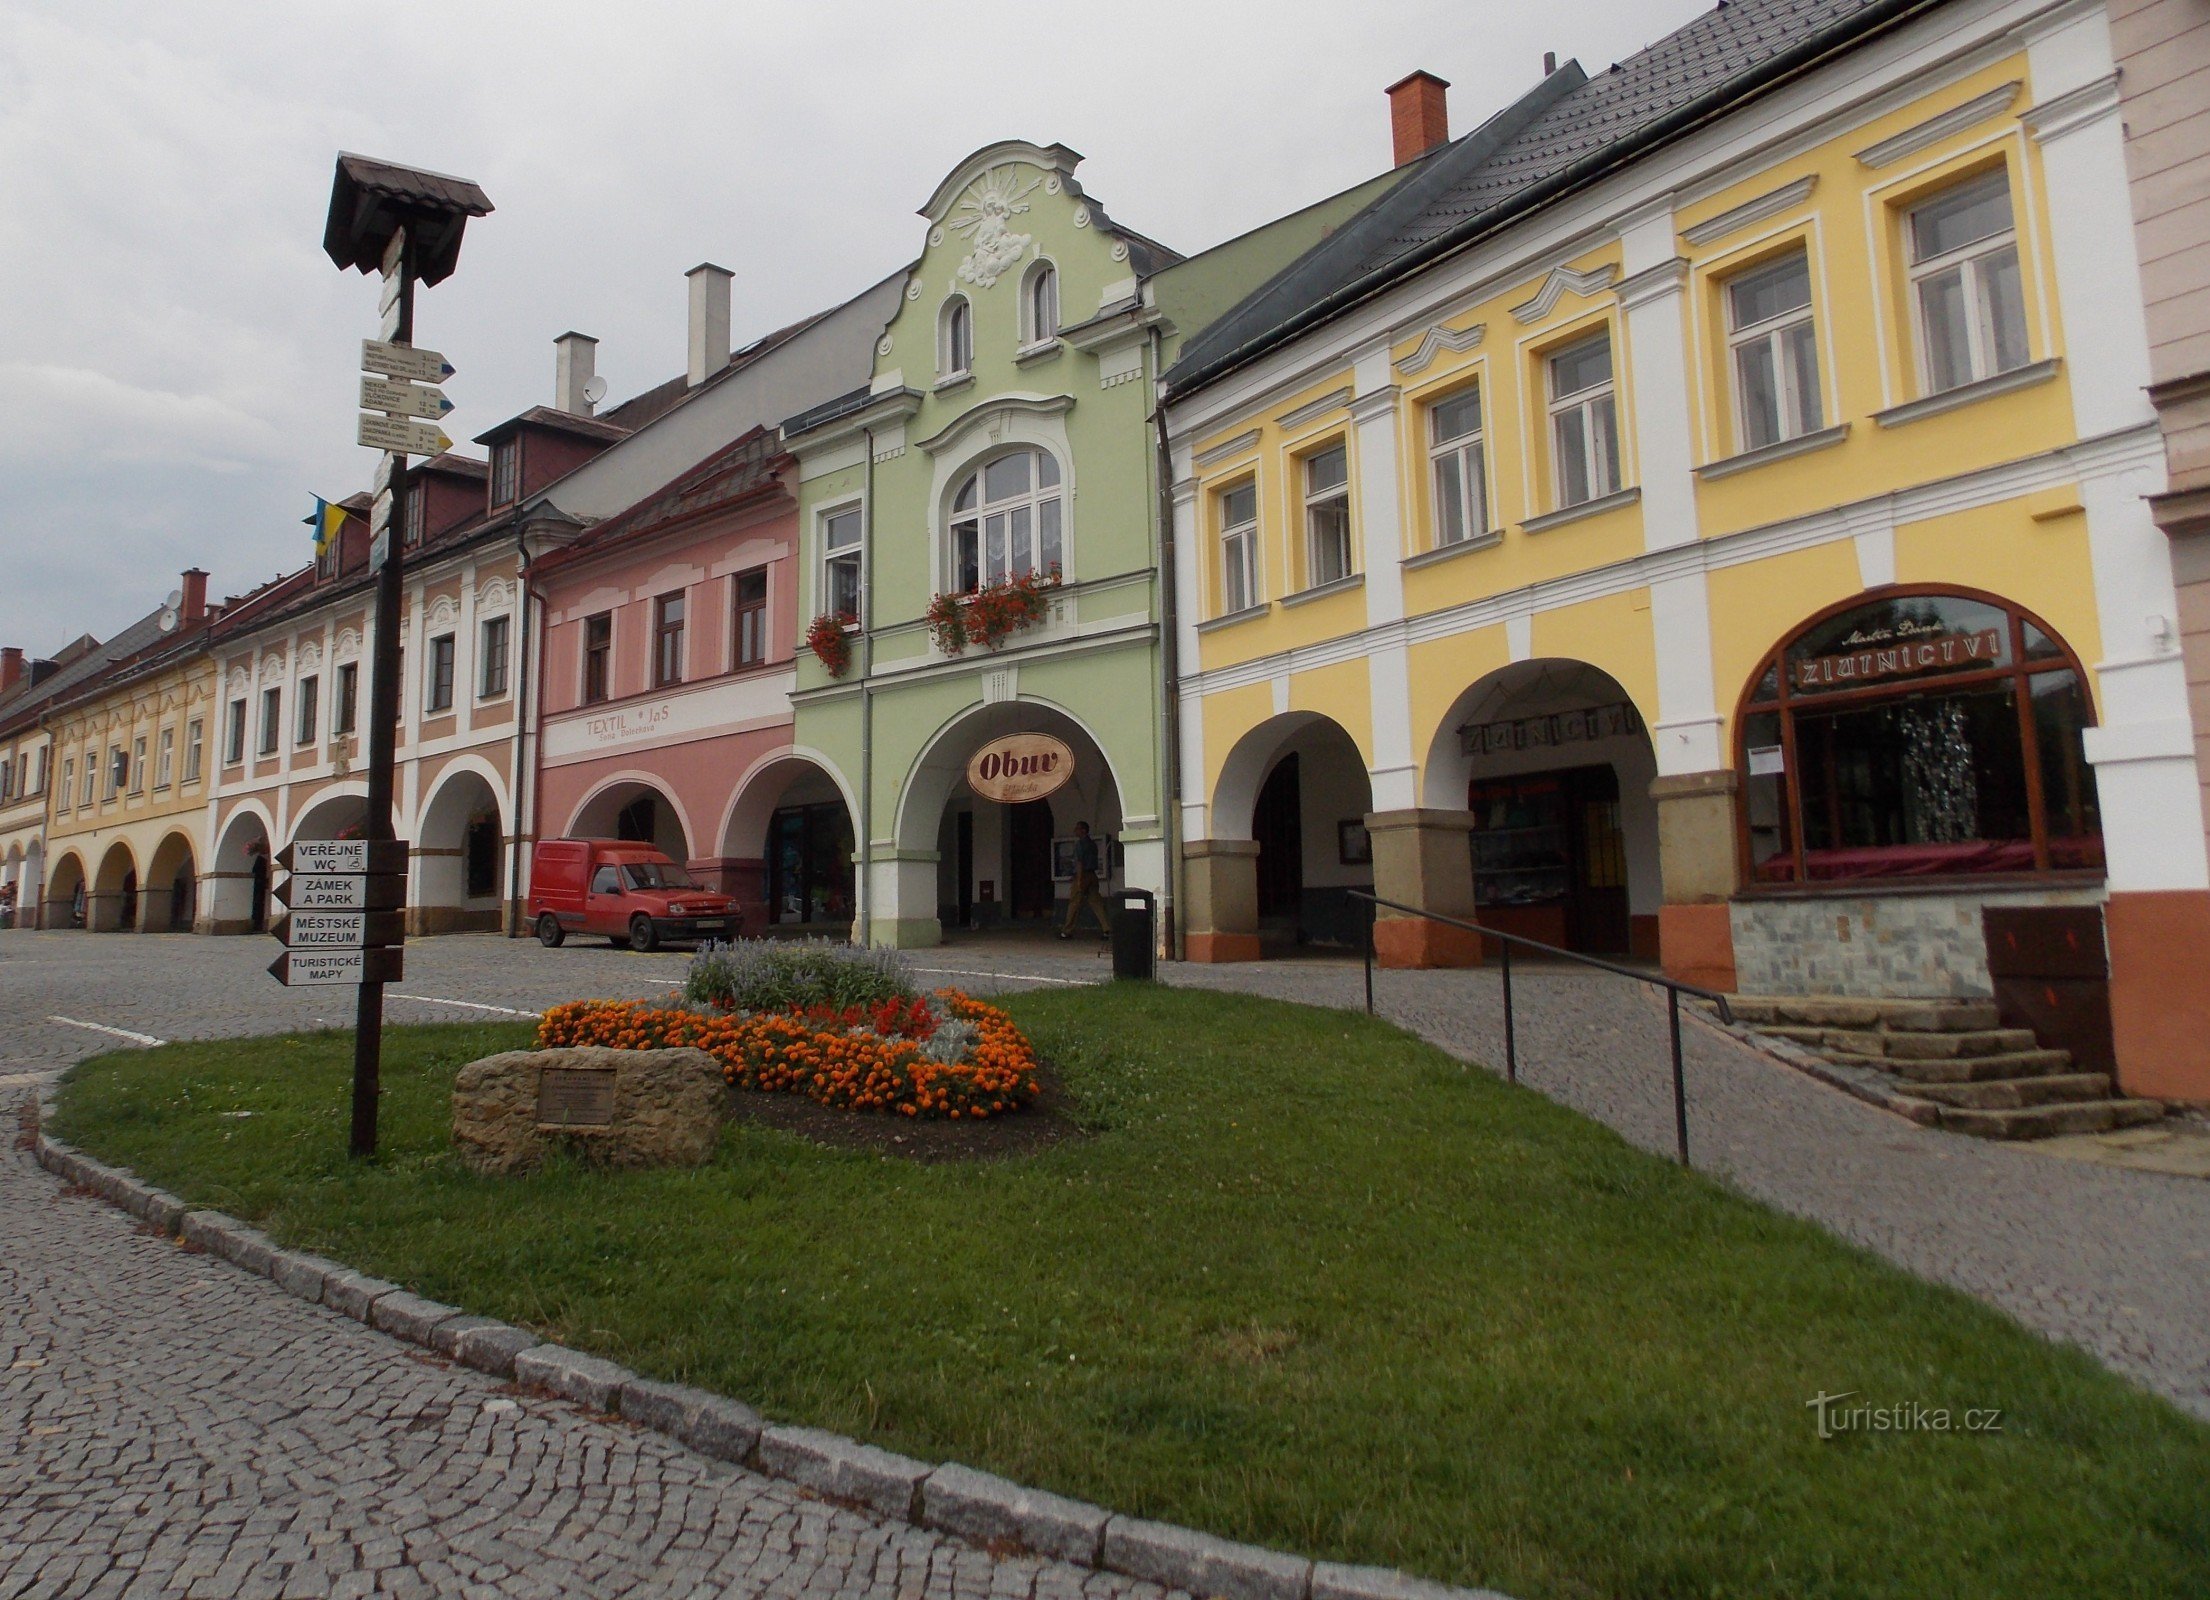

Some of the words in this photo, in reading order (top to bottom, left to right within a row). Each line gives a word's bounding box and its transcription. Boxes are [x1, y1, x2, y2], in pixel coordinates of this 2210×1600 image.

[587, 715, 627, 735] TEXTIL
[980, 751, 1058, 780] Obuv
[300, 843, 362, 856] VEŘEJNÉ
[314, 860, 336, 870] WC
[305, 879, 353, 891] ZÁMEK
[303, 894, 313, 904] A
[317, 894, 353, 904] PARK
[296, 916, 360, 929] MĚSTSKÉ
[298, 932, 356, 942] MUZEUM
[292, 954, 361, 968] TURISTICKÉ
[309, 970, 344, 979] MAPY
